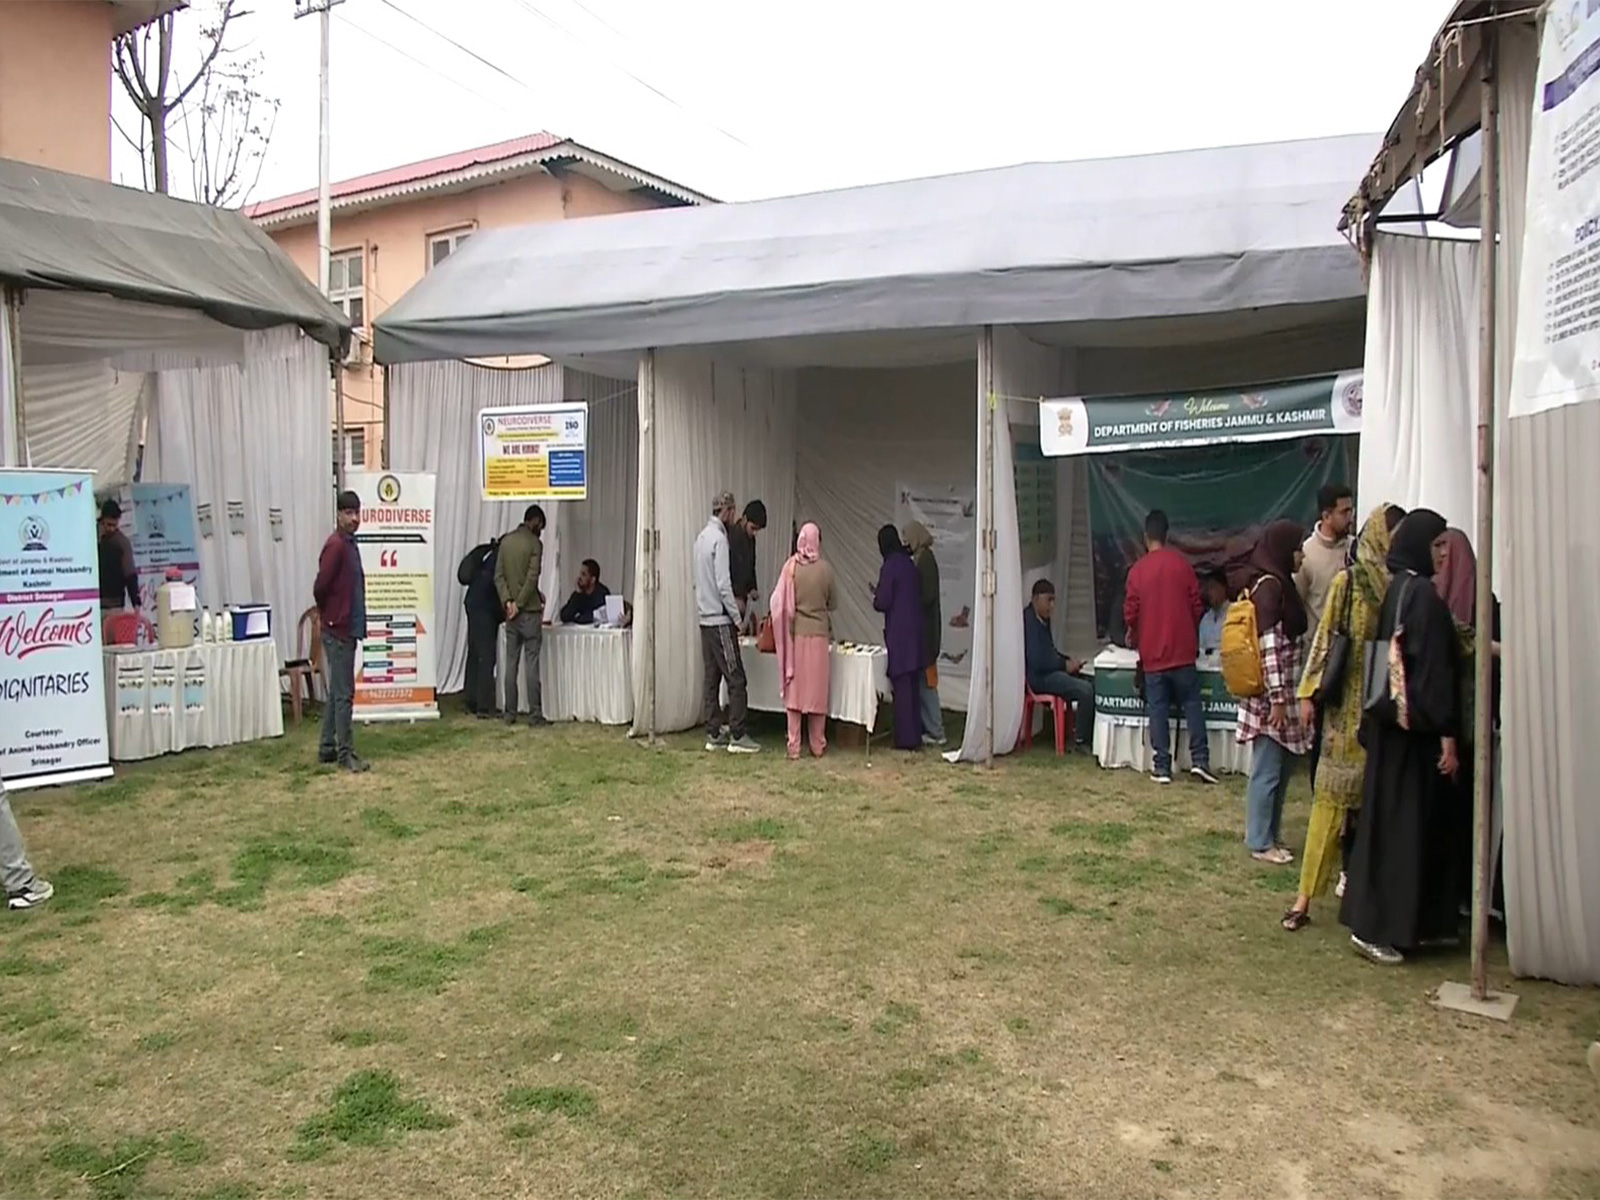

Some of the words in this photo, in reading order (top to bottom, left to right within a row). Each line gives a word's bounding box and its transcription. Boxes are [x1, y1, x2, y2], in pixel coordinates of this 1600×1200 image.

[498, 415, 552, 426] NEURODIVERSE
[1094, 420, 1159, 438] DEPARTMENT
[1161, 419, 1173, 433] OF
[1174, 416, 1223, 432] FISHERIES
[1225, 414, 1263, 428] JAMMU
[1265, 412, 1274, 425] &
[1275, 408, 1326, 422] KASHMIR
[361, 508, 431, 523] URODIVERSE
[55, 565, 92, 575] Husbandry
[23, 580, 52, 588] Kashmir
[1207, 701, 1239, 714] JAMM
[8, 746, 34, 755] Animal
[35, 740, 75, 751] Husbandry
[76, 738, 101, 747] Officer
[30, 757, 62, 766] Srinagar
